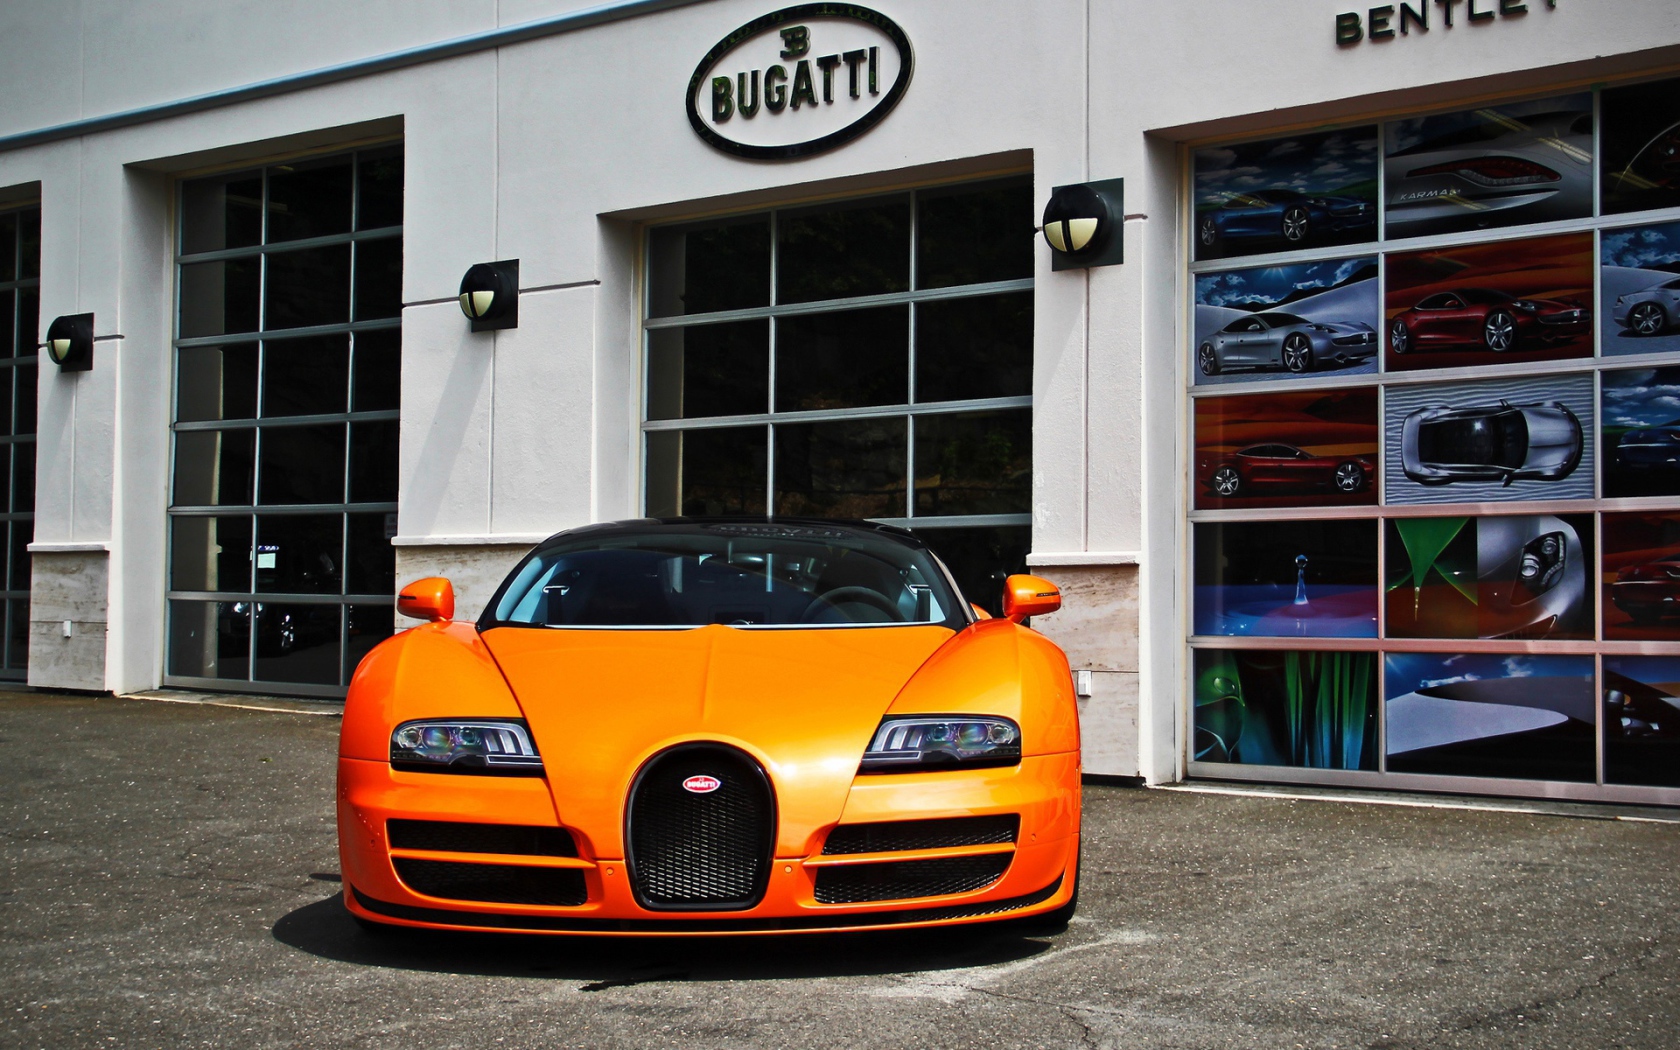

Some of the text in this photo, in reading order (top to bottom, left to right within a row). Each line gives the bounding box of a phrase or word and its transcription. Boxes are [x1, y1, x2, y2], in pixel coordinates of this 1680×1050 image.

[1336, 0, 1556, 45] BENTL
[712, 46, 880, 123] BUGATTI
[1400, 188, 1448, 201] KARMA
